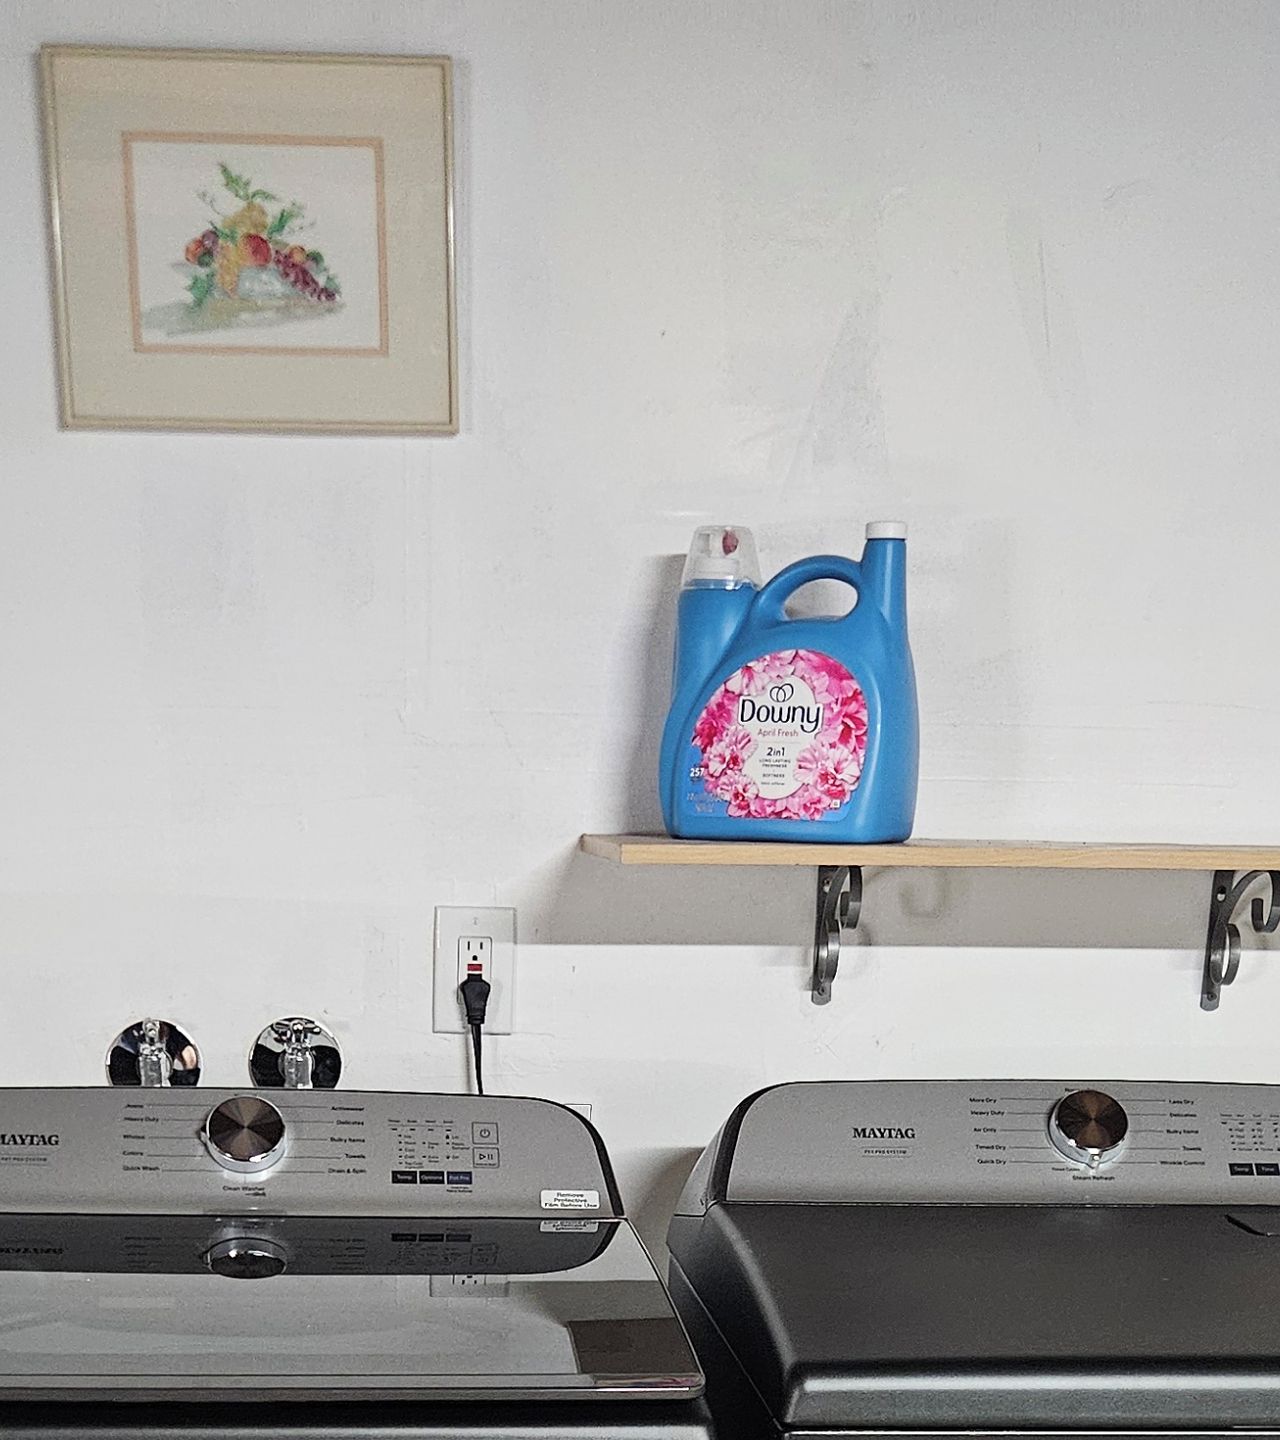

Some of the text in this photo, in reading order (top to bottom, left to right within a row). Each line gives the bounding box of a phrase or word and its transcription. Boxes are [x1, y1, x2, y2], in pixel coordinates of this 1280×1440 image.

[740, 698, 821, 733] Downy
[758, 728, 799, 738] April Fresh
[852, 1127, 916, 1139] MAYTAG
